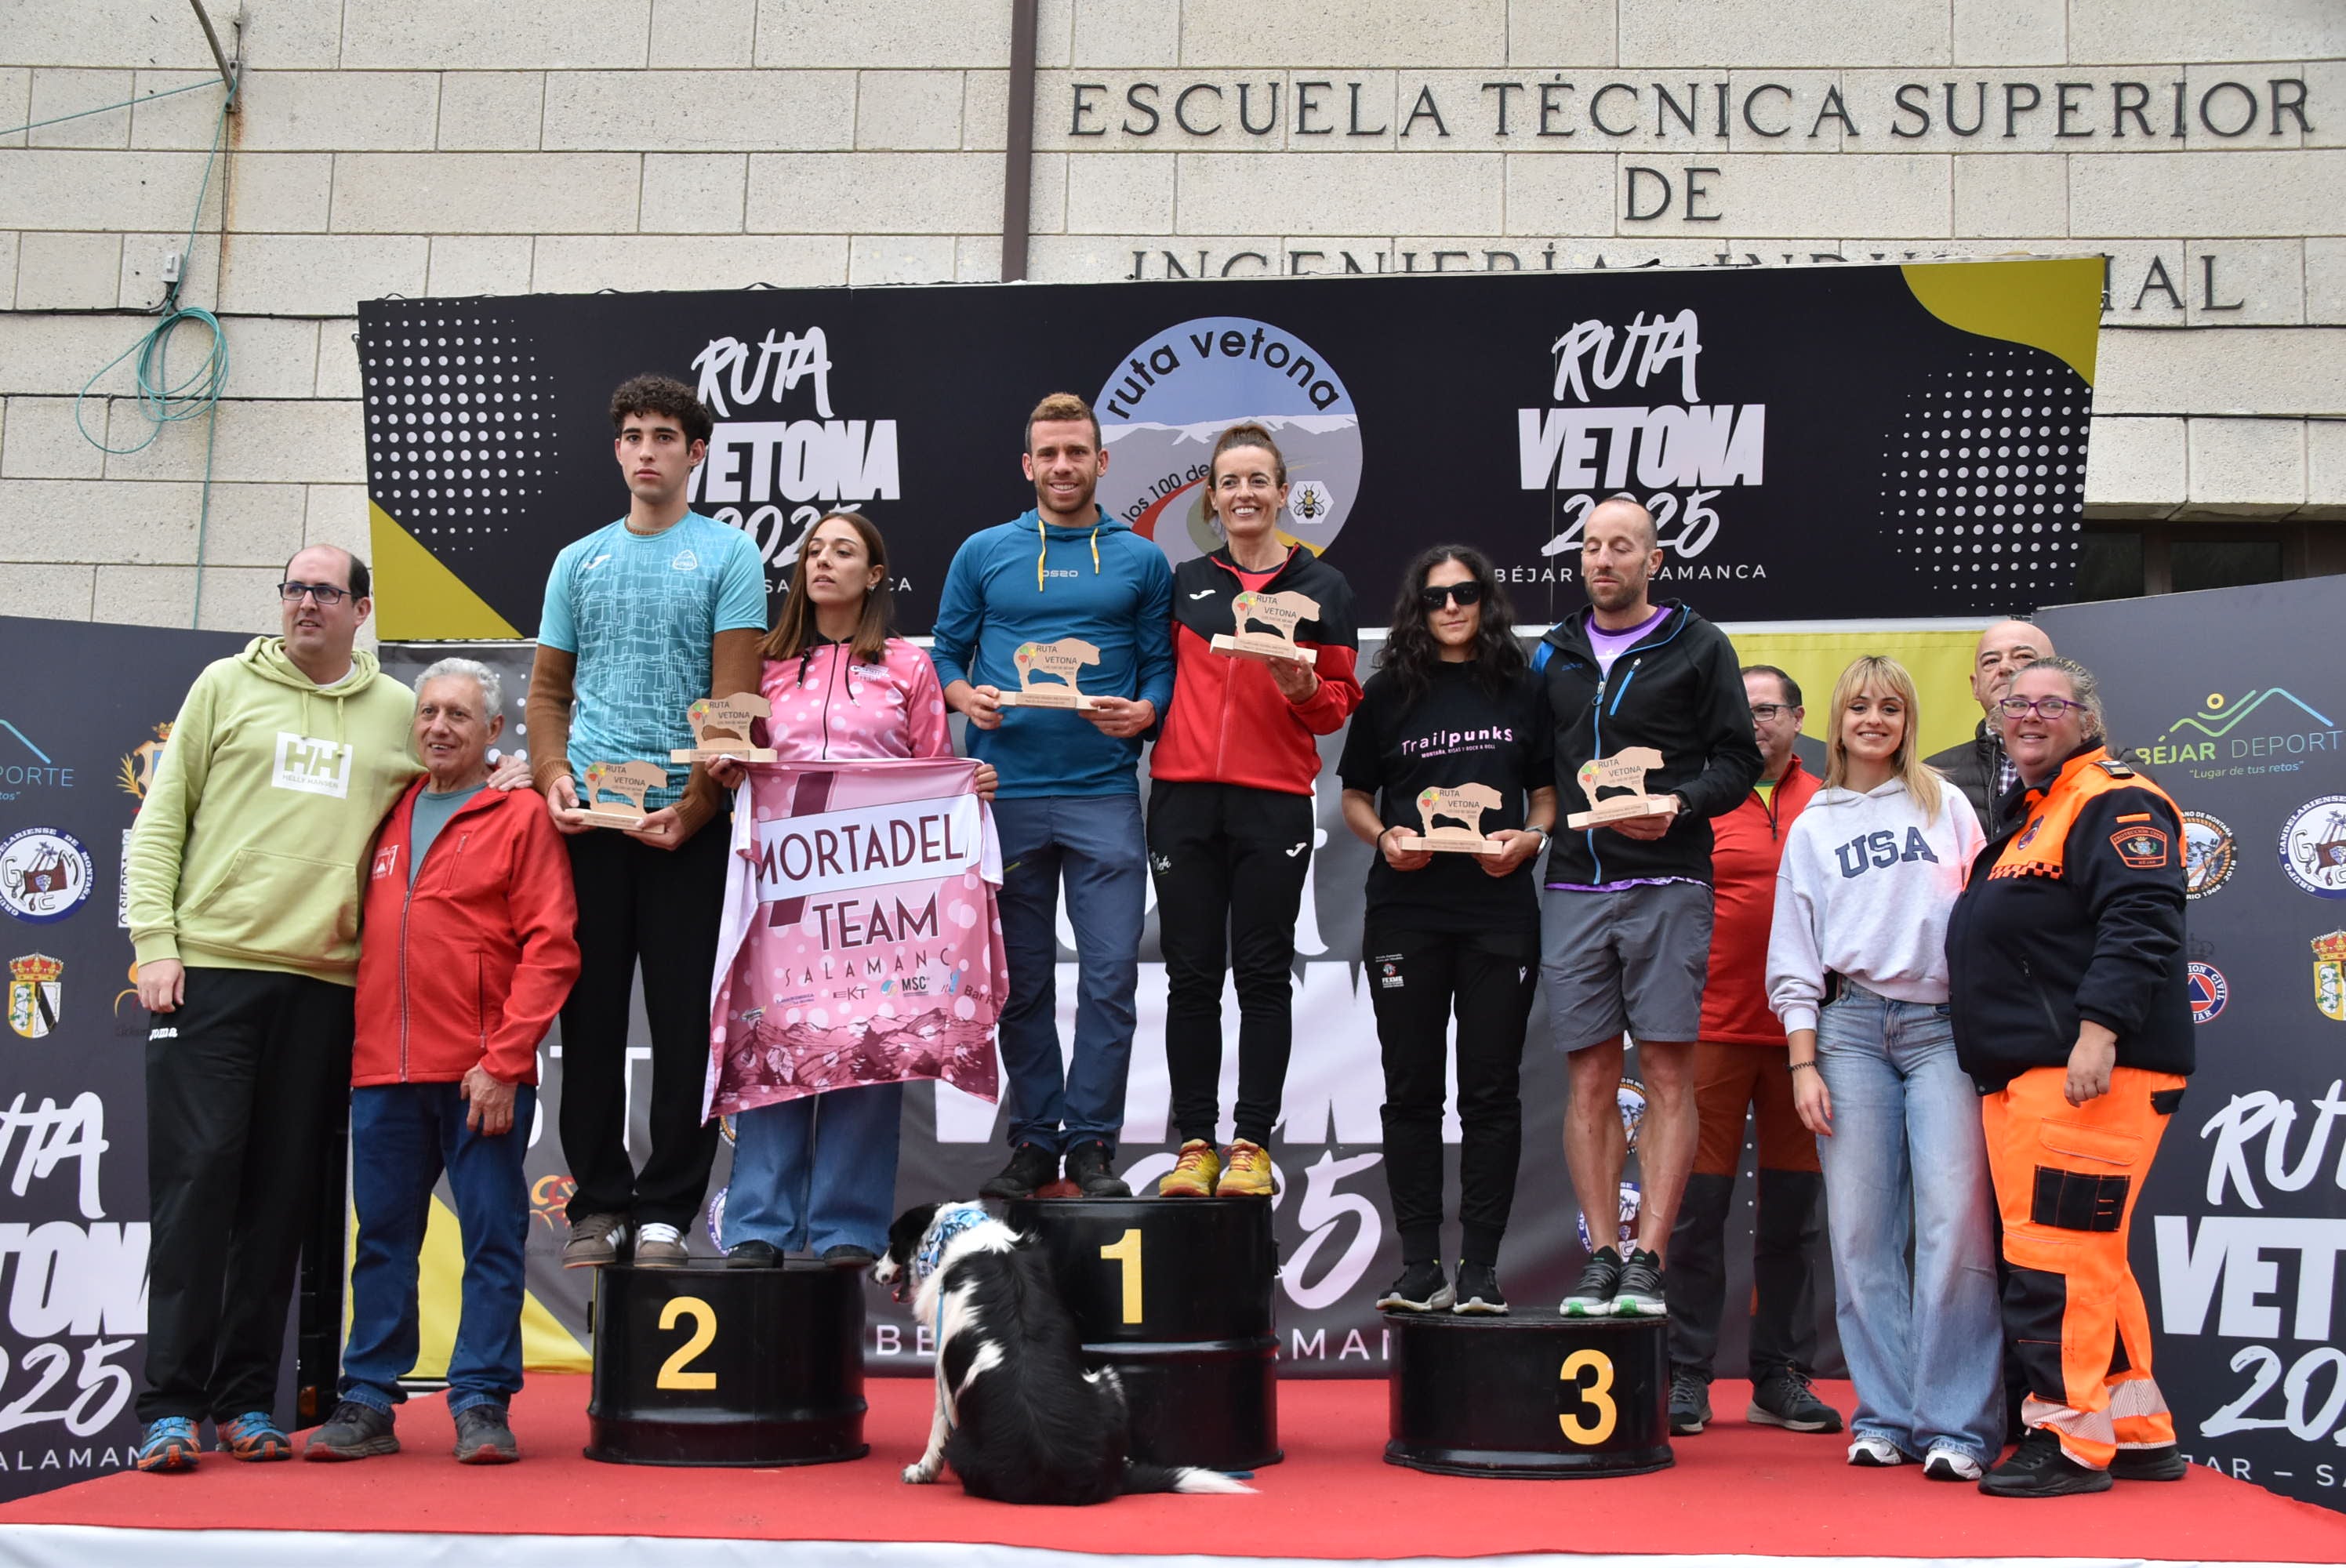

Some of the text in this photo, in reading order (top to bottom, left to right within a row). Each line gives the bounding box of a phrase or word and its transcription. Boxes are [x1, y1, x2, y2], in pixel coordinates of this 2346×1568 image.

[1070, 72, 2315, 139] ESCUELA TÉCNICA SUPERIOR
[1622, 165, 1723, 223] DE
[691, 326, 834, 418] RUTA
[1104, 325, 1340, 420] ruta vetona
[1552, 309, 1702, 403] RUTA
[1518, 404, 1766, 491] VETONA
[1121, 463, 1210, 523] los 100 de
[1542, 489, 1722, 558] 225
[1494, 565, 1573, 583] BÉJAR
[1045, 656, 1077, 665] VETONA
[1401, 725, 1513, 757] Trailpunks
[2135, 735, 2217, 766] BÉJAR
[605, 764, 627, 775] RUTA
[614, 776, 645, 786] VETONA
[1598, 758, 1620, 768] RUTA
[1608, 765, 1642, 777] VETONA
[2230, 765, 2244, 776] de
[2247, 764, 2265, 775] tus
[1439, 789, 1460, 797] RUTA
[1448, 800, 1480, 808] VETONA
[0, 827, 93, 901] ELARIENSE DE MONTAÑA
[758, 813, 969, 885] MORTADEL
[1835, 826, 1939, 879] USA
[2203, 884, 2221, 897] 1968
[2224, 859, 2237, 882] 2018
[2283, 863, 2316, 893] GRUPO
[0, 896, 20, 916] GRU
[812, 891, 939, 951] TEAM
[902, 975, 927, 991] MSC
[964, 985, 984, 1001] Bar
[2211, 974, 2225, 1000] CIVIL
[1100, 1229, 1142, 1323] 1
[657, 1297, 717, 1388] 2
[0, 1338, 136, 1437] 25
[1559, 1349, 1617, 1446] 3
